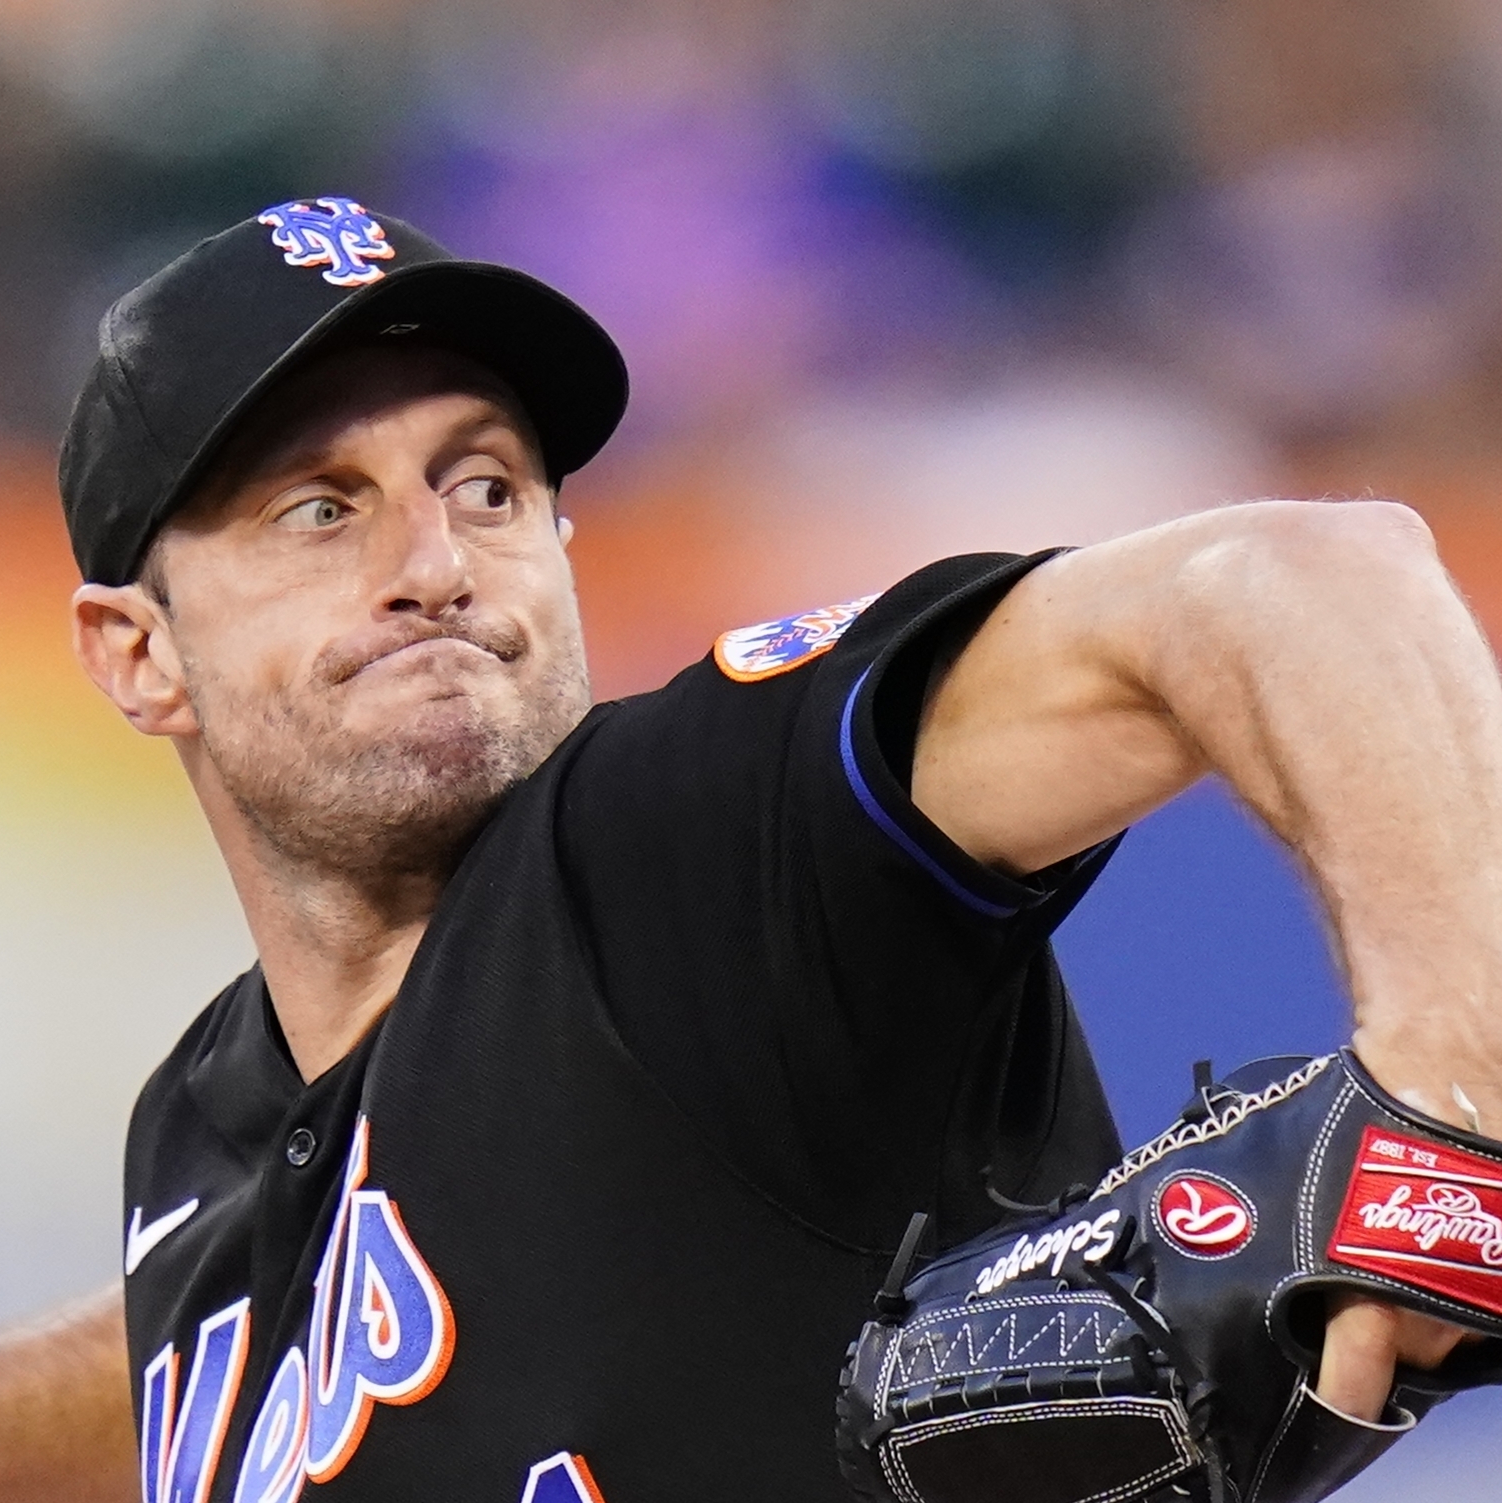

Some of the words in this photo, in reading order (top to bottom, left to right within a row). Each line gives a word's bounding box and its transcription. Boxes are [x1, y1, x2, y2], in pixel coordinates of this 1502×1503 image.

[257, 195, 395, 287] NY
[1368, 1137, 1407, 1160] 1887
[1165, 1180, 1247, 1245] R
[976, 1208, 1121, 1294] Scherzer
